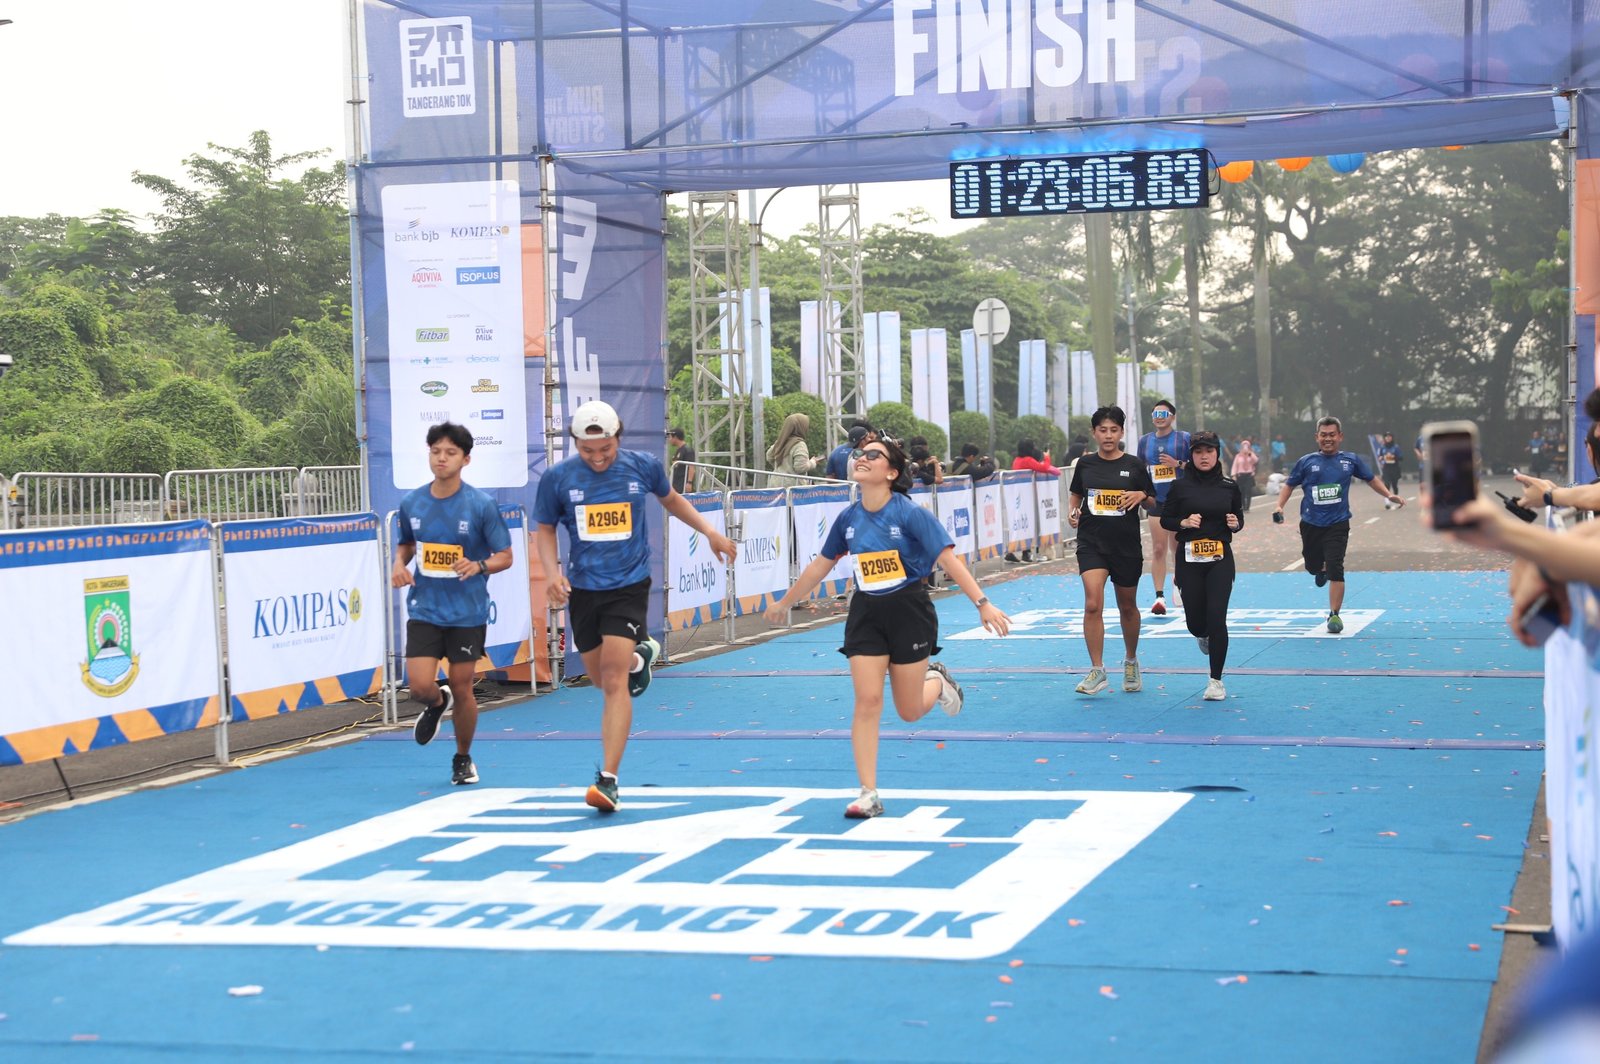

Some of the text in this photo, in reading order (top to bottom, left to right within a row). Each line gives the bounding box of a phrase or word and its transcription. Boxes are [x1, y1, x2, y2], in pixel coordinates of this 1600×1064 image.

[894, 0, 1136, 97] FINISH
[407, 94, 472, 110] TANGERANG 10K
[394, 230, 440, 242] bank bjb
[450, 226, 501, 238] KOMPAS
[411, 271, 442, 283] AQUVIVA
[459, 271, 499, 282] ISOPLUS
[418, 330, 448, 341] Fitbar
[588, 510, 627, 527] A2964
[744, 536, 777, 565] KOMPAS
[1194, 541, 1218, 553] B1557
[424, 550, 459, 565] A2966
[860, 557, 899, 576] B2965
[679, 560, 716, 593] bank bjb
[97, 901, 1006, 940] TANGERANG 10K
